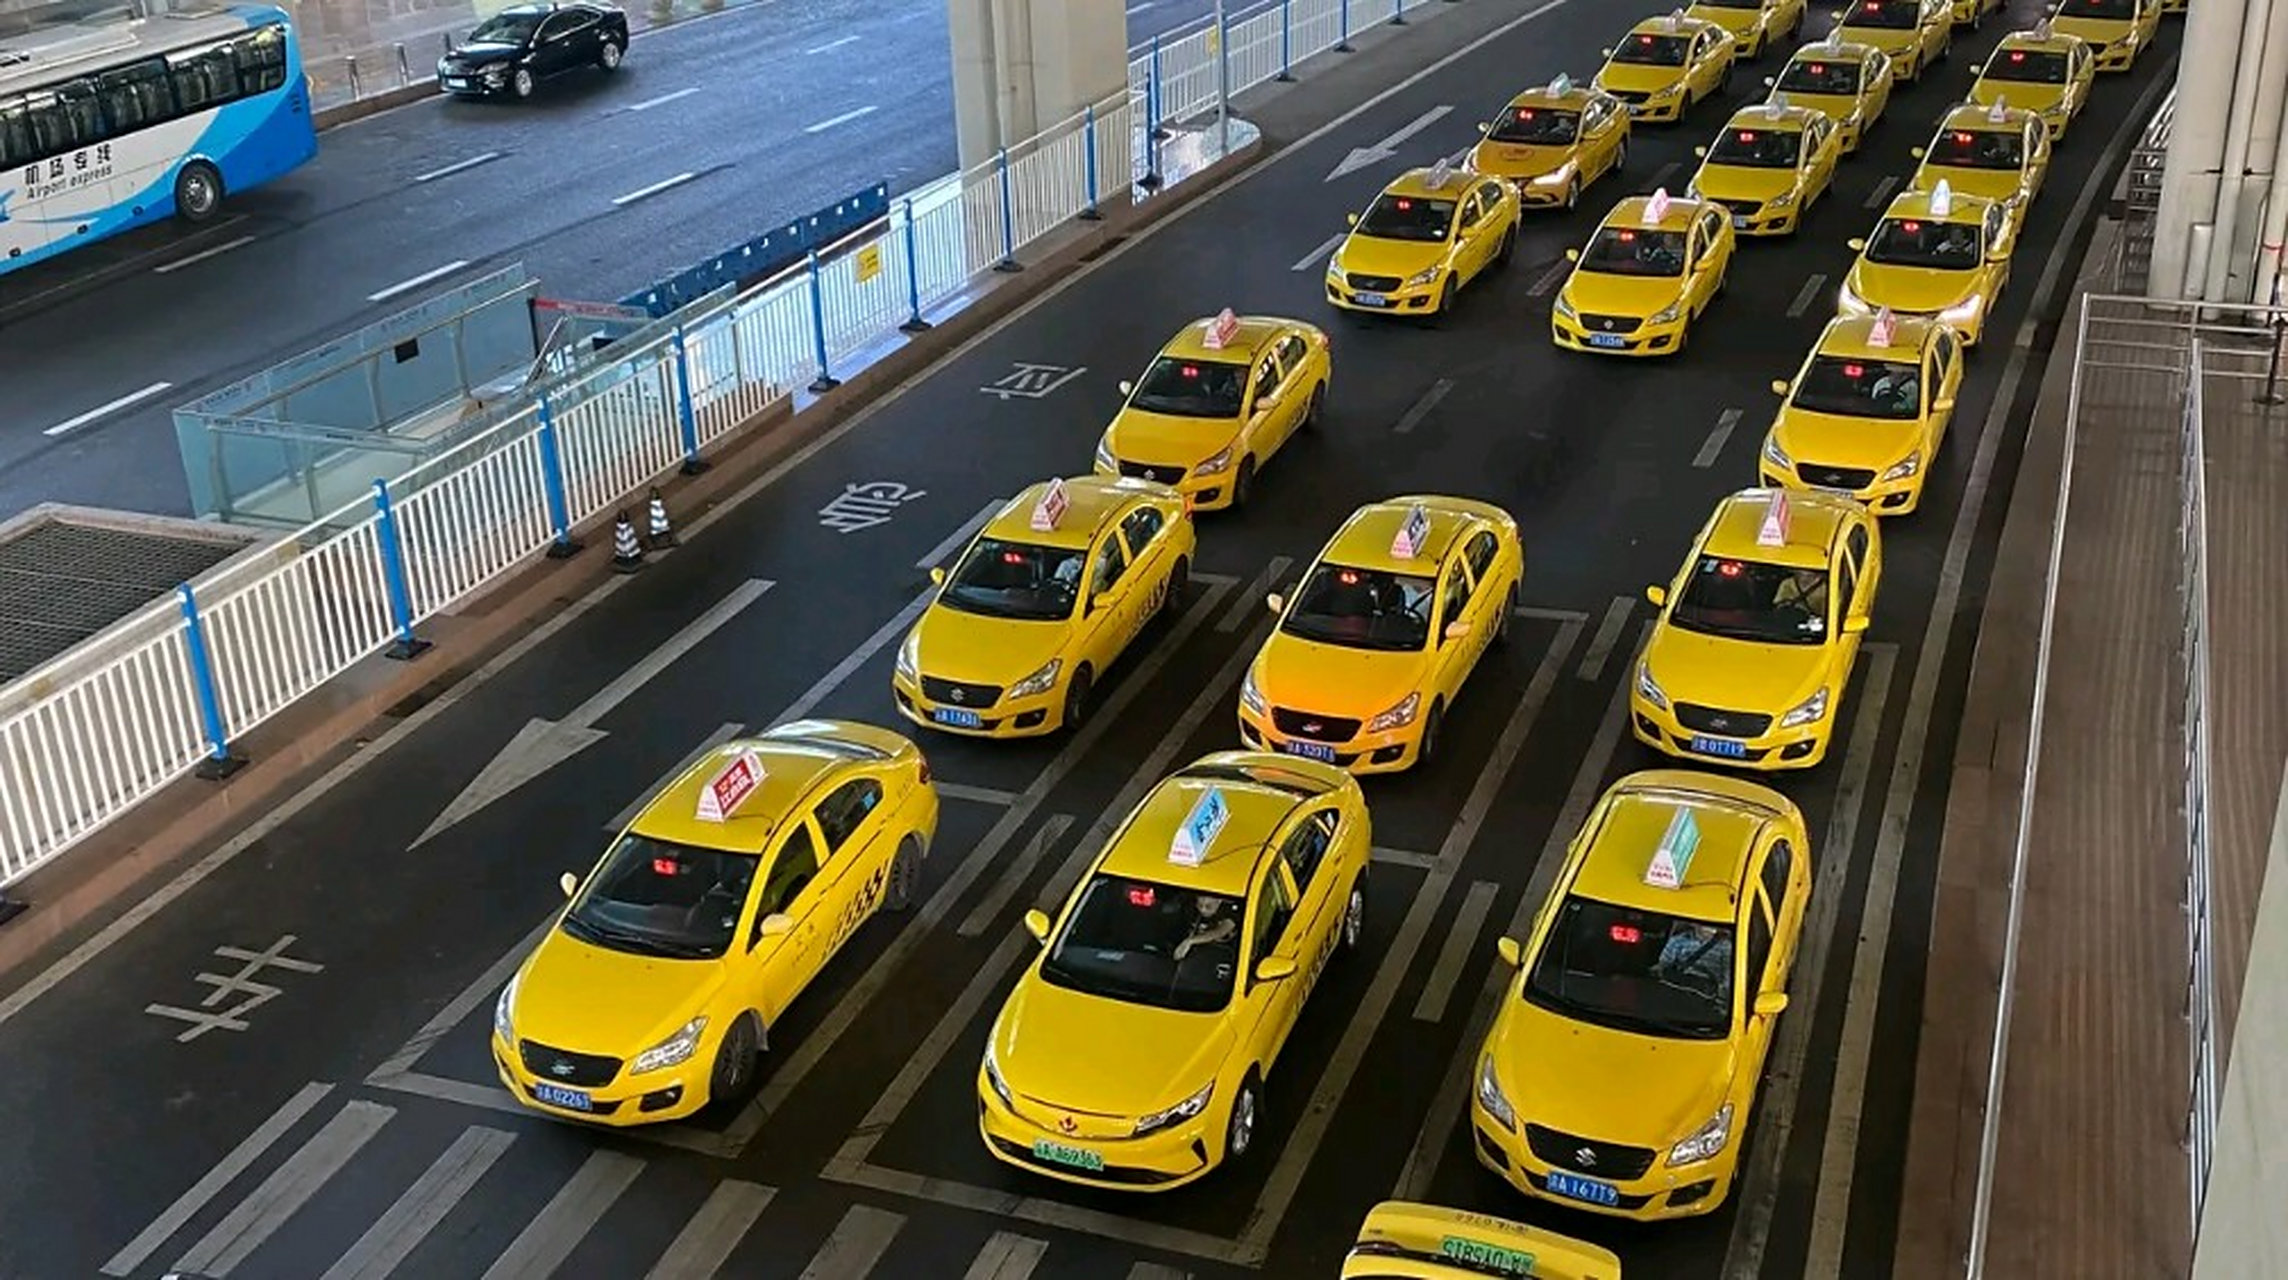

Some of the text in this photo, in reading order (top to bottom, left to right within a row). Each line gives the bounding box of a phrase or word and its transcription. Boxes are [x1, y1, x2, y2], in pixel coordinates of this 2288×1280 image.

[25, 143, 111, 186] 机场专线
[27, 164, 112, 199] Airport express
[145, 935, 325, 1042] 车
